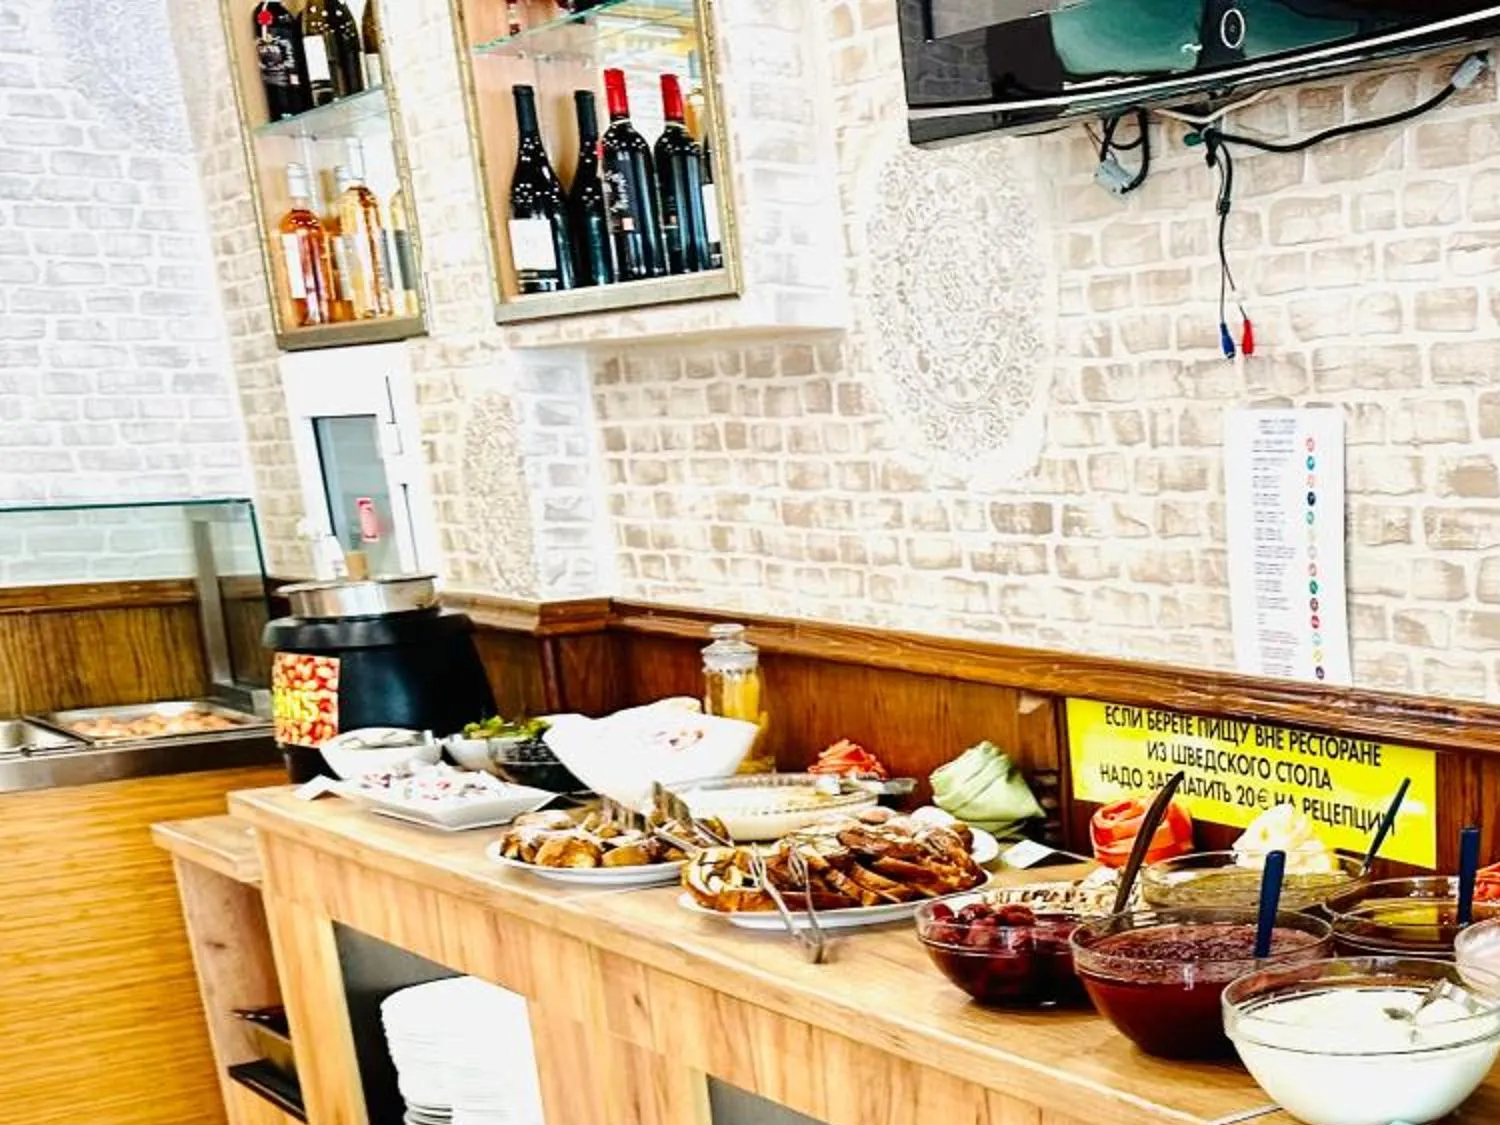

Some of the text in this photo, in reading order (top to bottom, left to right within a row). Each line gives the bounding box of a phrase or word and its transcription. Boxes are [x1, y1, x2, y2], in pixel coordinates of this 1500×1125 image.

[1105, 705, 1381, 767] ЕСЛИ БЕРЕТЕ ПИЩУ ВНЕ РЕСТОРАНЕ
[1100, 763, 1143, 789] НАДО
[1147, 740, 1333, 791] ИЗ ШВЕДСКОГО СТОЛА
